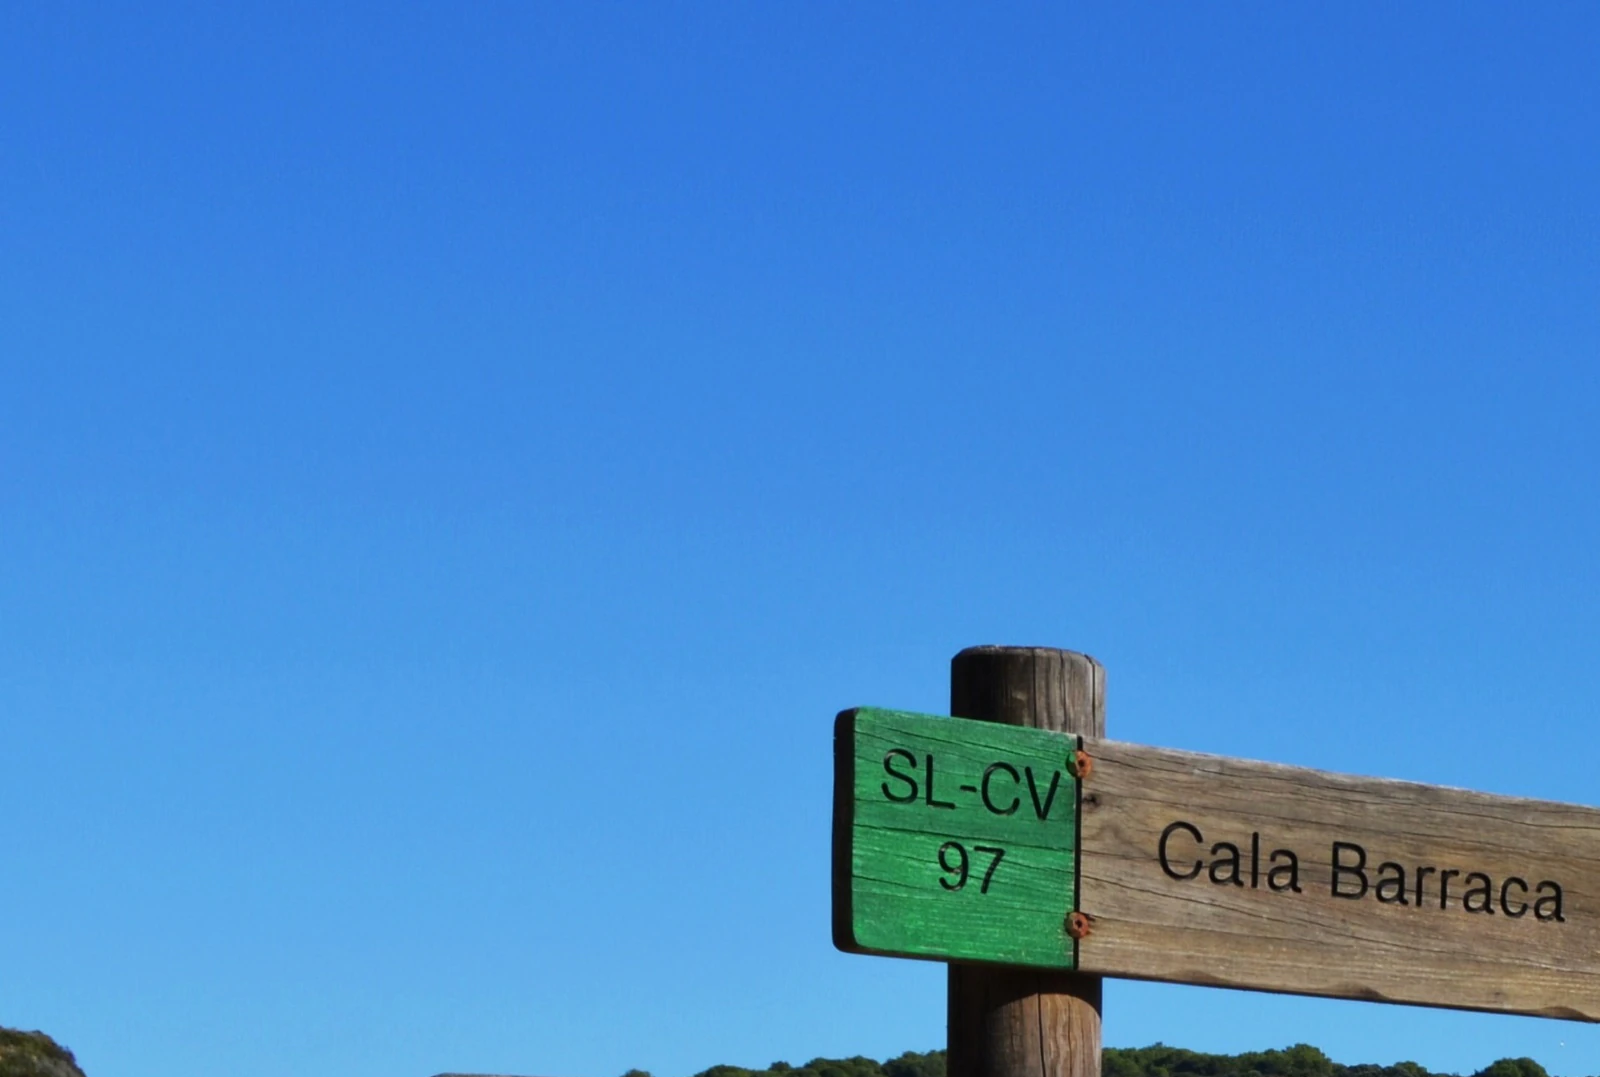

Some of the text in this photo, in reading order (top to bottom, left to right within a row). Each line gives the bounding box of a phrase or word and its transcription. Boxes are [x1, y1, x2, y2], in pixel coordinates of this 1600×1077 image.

[880, 747, 1061, 821] SL-CV
[938, 840, 1006, 894] 97
[1158, 820, 1566, 922] Cala Barraca
